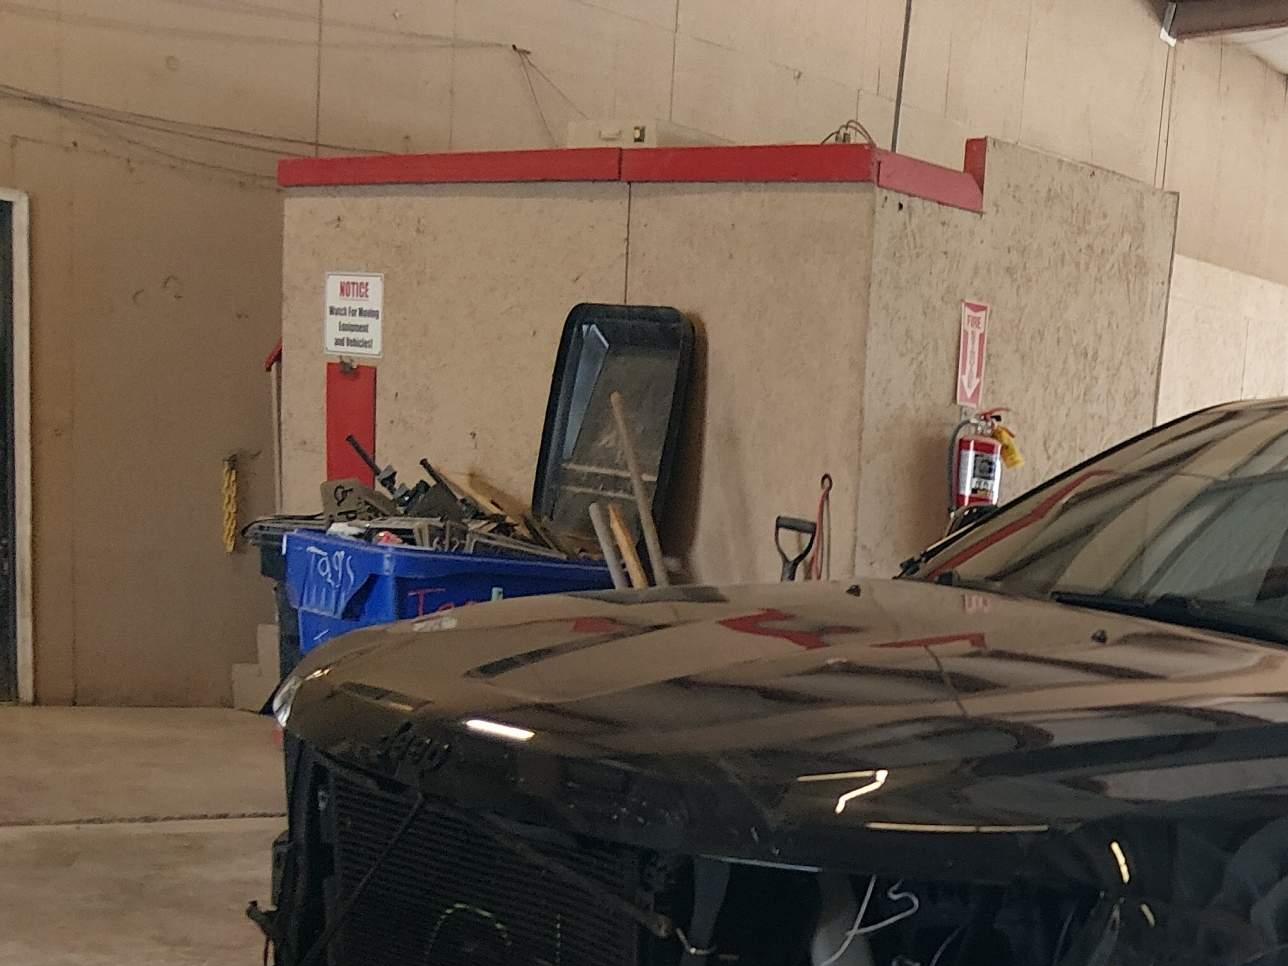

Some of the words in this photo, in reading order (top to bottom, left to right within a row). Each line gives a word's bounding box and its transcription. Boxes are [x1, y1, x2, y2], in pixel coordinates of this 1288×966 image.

[340, 281, 369, 298] NOTICE
[329, 305, 347, 316] Watch
[348, 306, 358, 317] For
[358, 307, 380, 320] Moving
[338, 321, 369, 333] Equipment
[967, 315, 982, 329] FIRE
[335, 337, 345, 347] and
